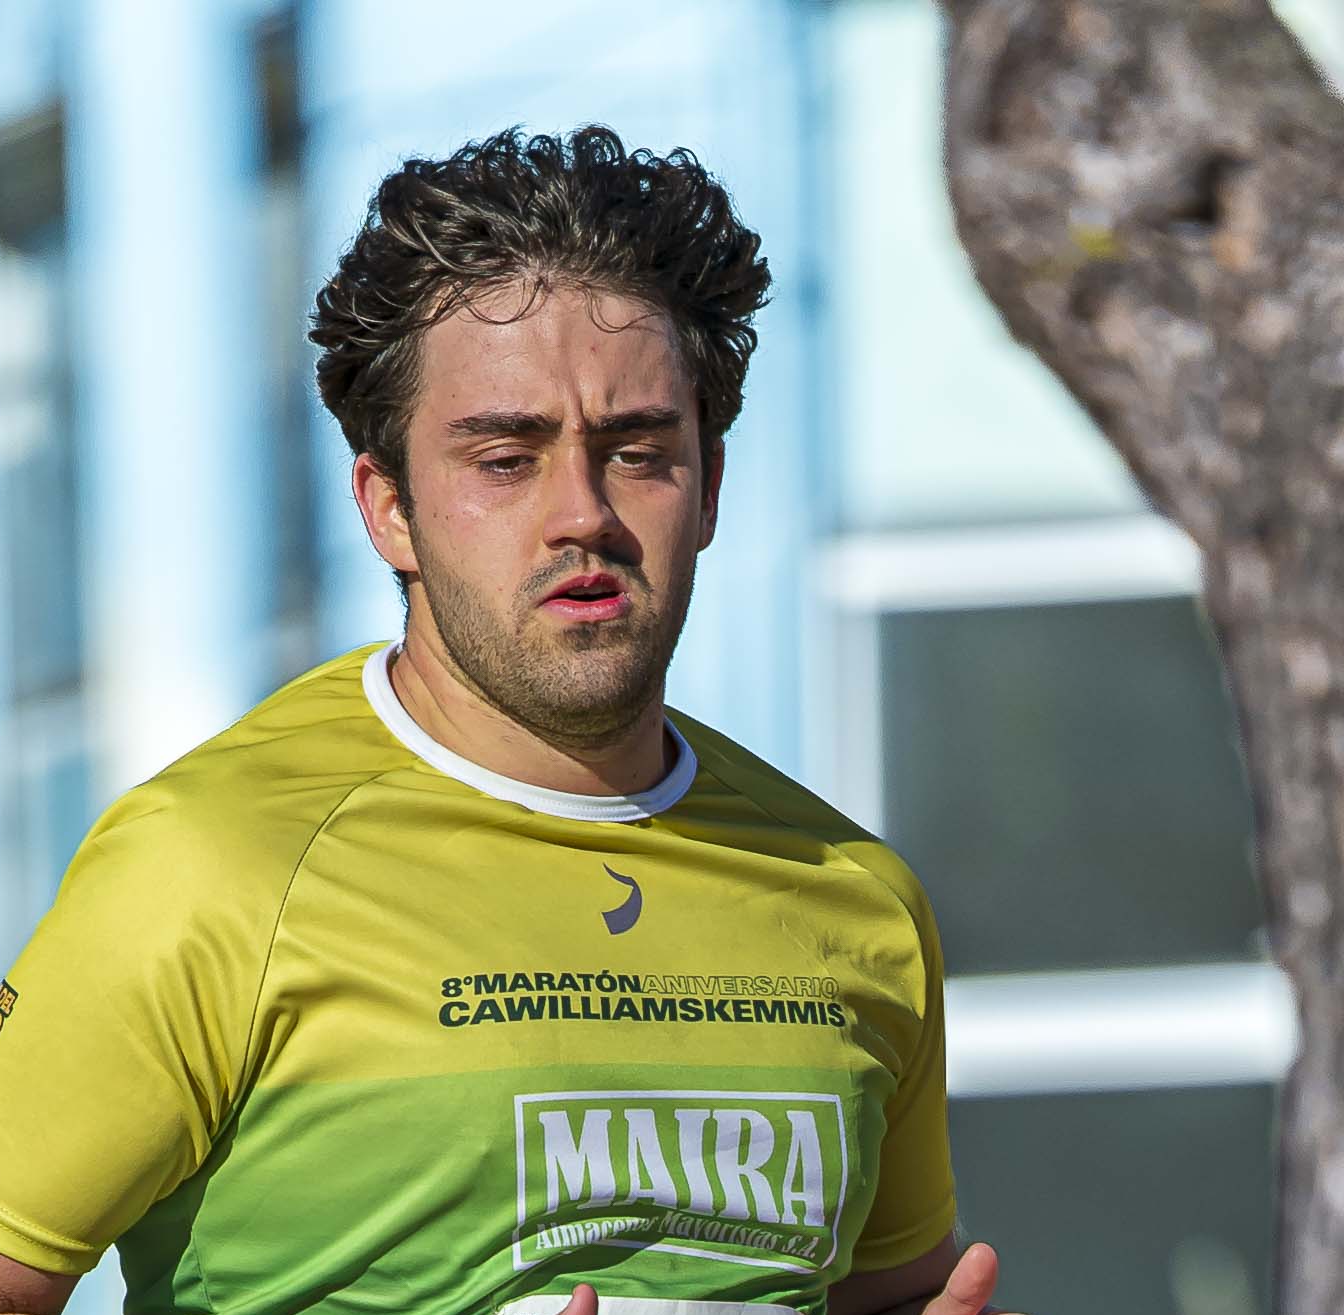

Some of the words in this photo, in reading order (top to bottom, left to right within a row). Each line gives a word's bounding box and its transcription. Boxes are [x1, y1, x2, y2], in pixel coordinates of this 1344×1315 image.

[439, 995, 846, 1028] CAWILLIAMSKEMMIS
[538, 1108, 825, 1228] MAIRA
[658, 1211, 783, 1250] Mayoristas
